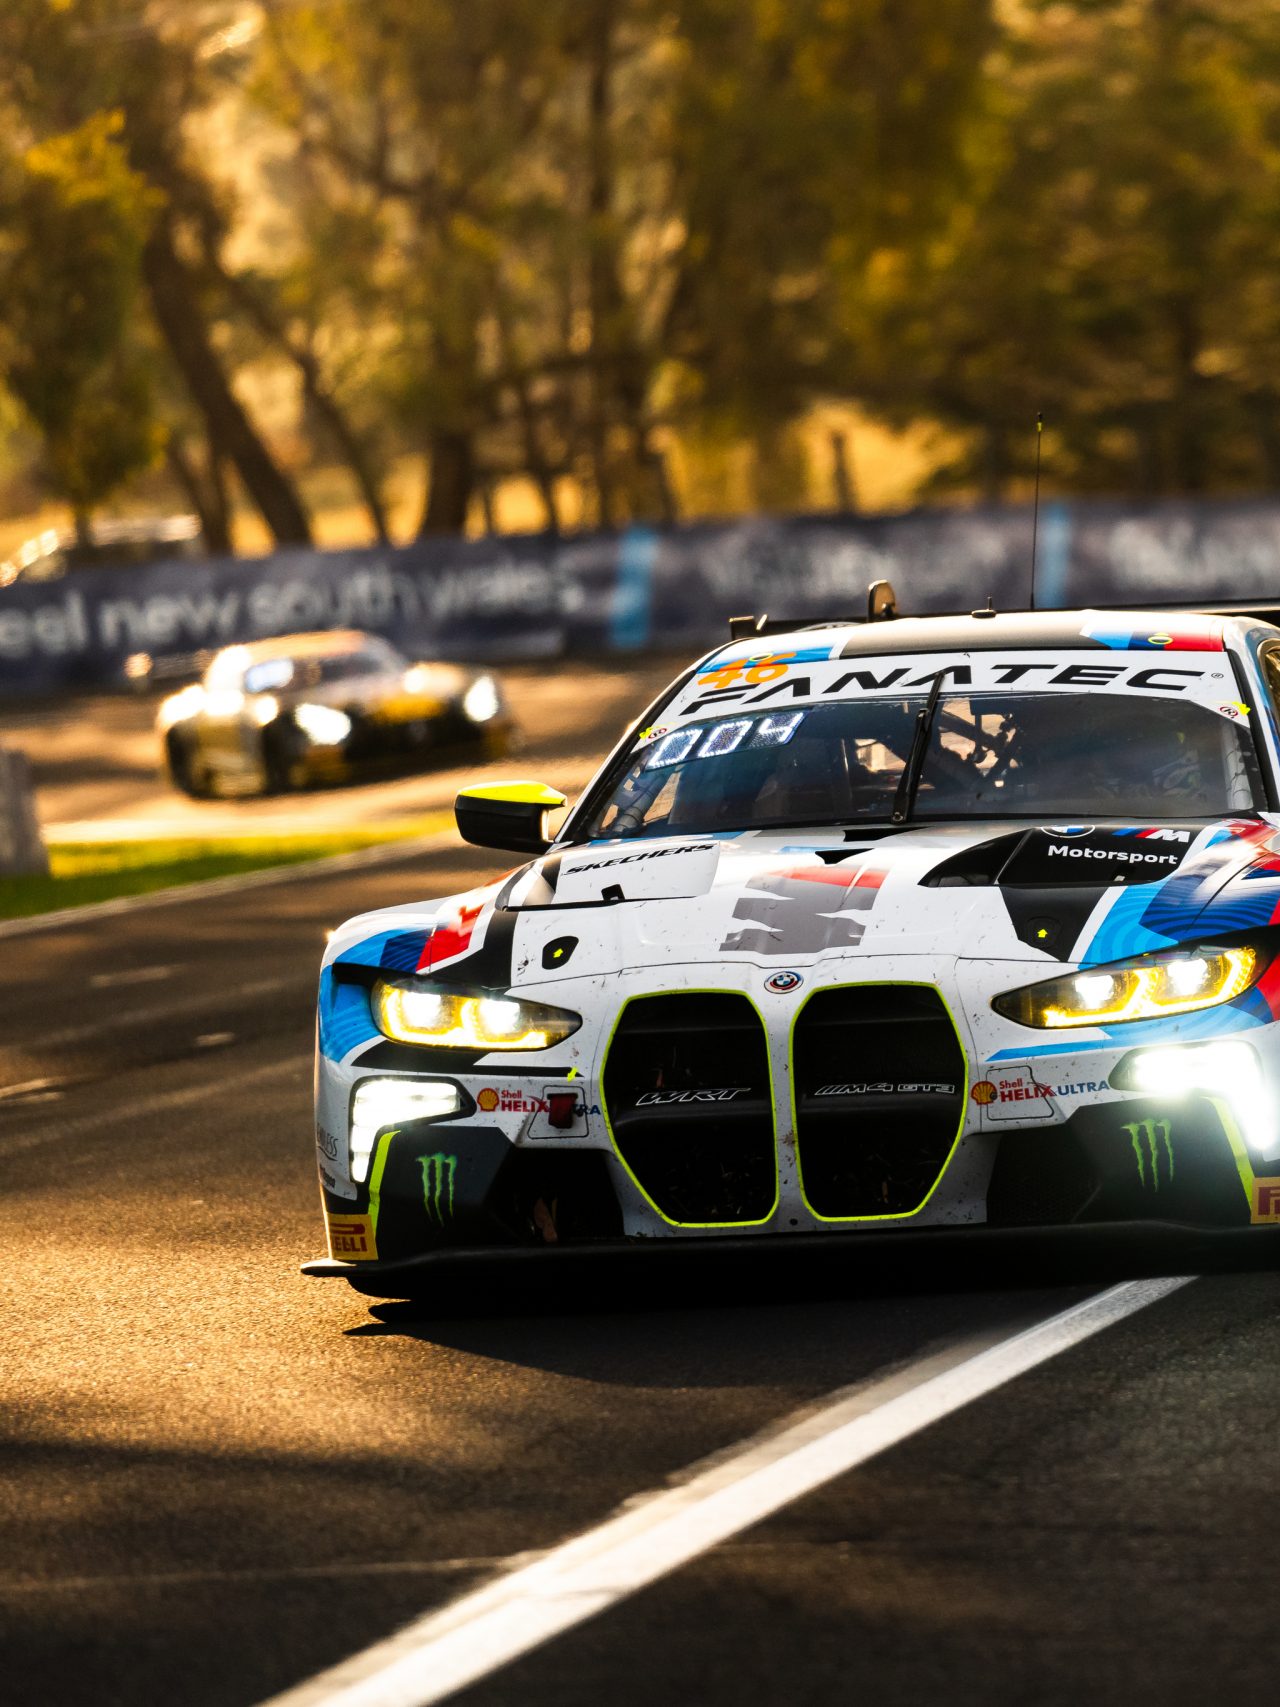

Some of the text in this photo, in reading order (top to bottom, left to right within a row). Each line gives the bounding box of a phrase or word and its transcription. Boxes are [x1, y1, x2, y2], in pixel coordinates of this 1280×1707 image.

[101, 590, 241, 648] new
[251, 565, 421, 628] south
[697, 652, 797, 689] 46
[678, 664, 1206, 716] FANATEC
[648, 712, 804, 770] 004
[560, 843, 718, 876] SKECHERS
[1047, 844, 1178, 865] Motorsport
[500, 1089, 522, 1099] Shell
[999, 1078, 1023, 1089] Shell
[1000, 1080, 1109, 1102] HELIX ULTRA
[501, 1100, 550, 1113] HELIX
[636, 1087, 752, 1106] WRT
